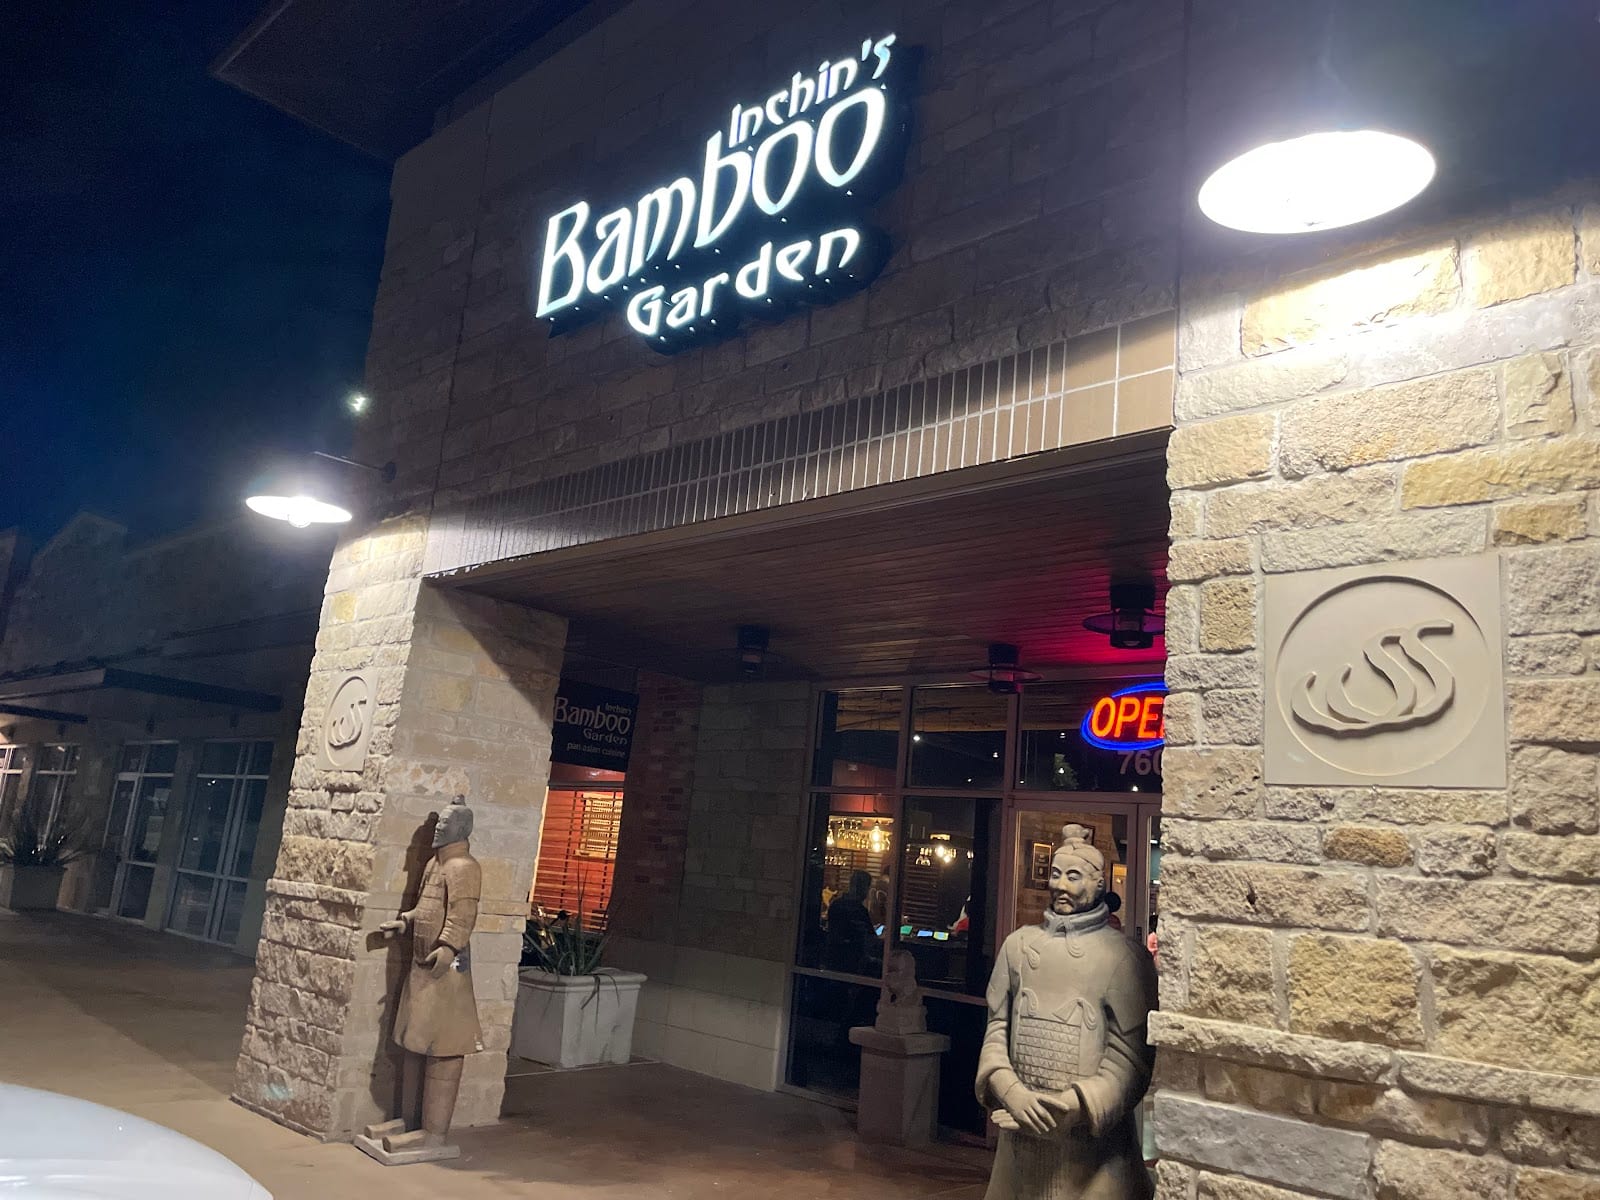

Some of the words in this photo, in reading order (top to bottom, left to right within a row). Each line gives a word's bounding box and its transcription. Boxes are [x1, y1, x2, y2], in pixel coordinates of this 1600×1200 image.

[728, 33, 896, 148] Inchin's
[535, 87, 886, 318] Bamboo
[626, 228, 860, 335] Garden
[555, 696, 631, 735] Bamboo
[583, 728, 628, 745] Garden
[1091, 696, 1165, 738] OPE
[566, 742, 581, 751] pan
